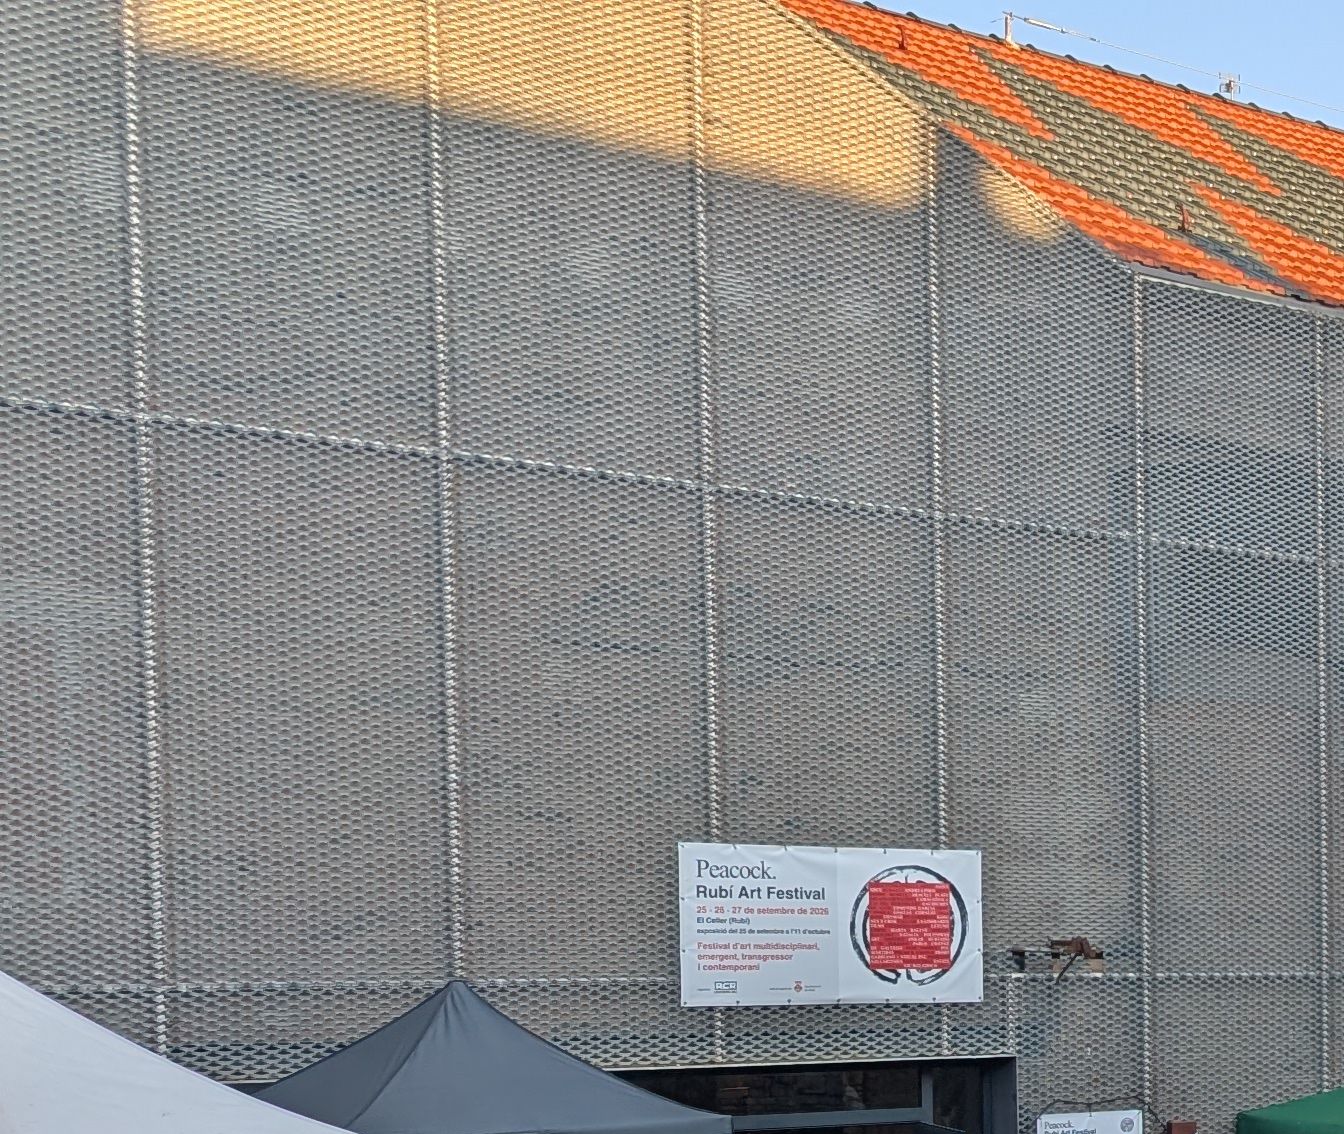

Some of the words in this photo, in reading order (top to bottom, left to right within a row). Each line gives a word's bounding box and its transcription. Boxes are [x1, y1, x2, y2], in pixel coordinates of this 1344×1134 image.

[696, 859, 777, 880] Peacock.
[696, 885, 734, 899] Rubí
[738, 886, 762, 899] Art
[767, 887, 825, 900] Festival
[732, 906, 742, 914] 27
[744, 906, 755, 914] de
[757, 907, 796, 915] setembre
[797, 907, 807, 915] de
[697, 942, 731, 950] Festival
[732, 942, 751, 950] d'art
[742, 954, 793, 962] transgressor
[702, 963, 760, 972] contemporani
